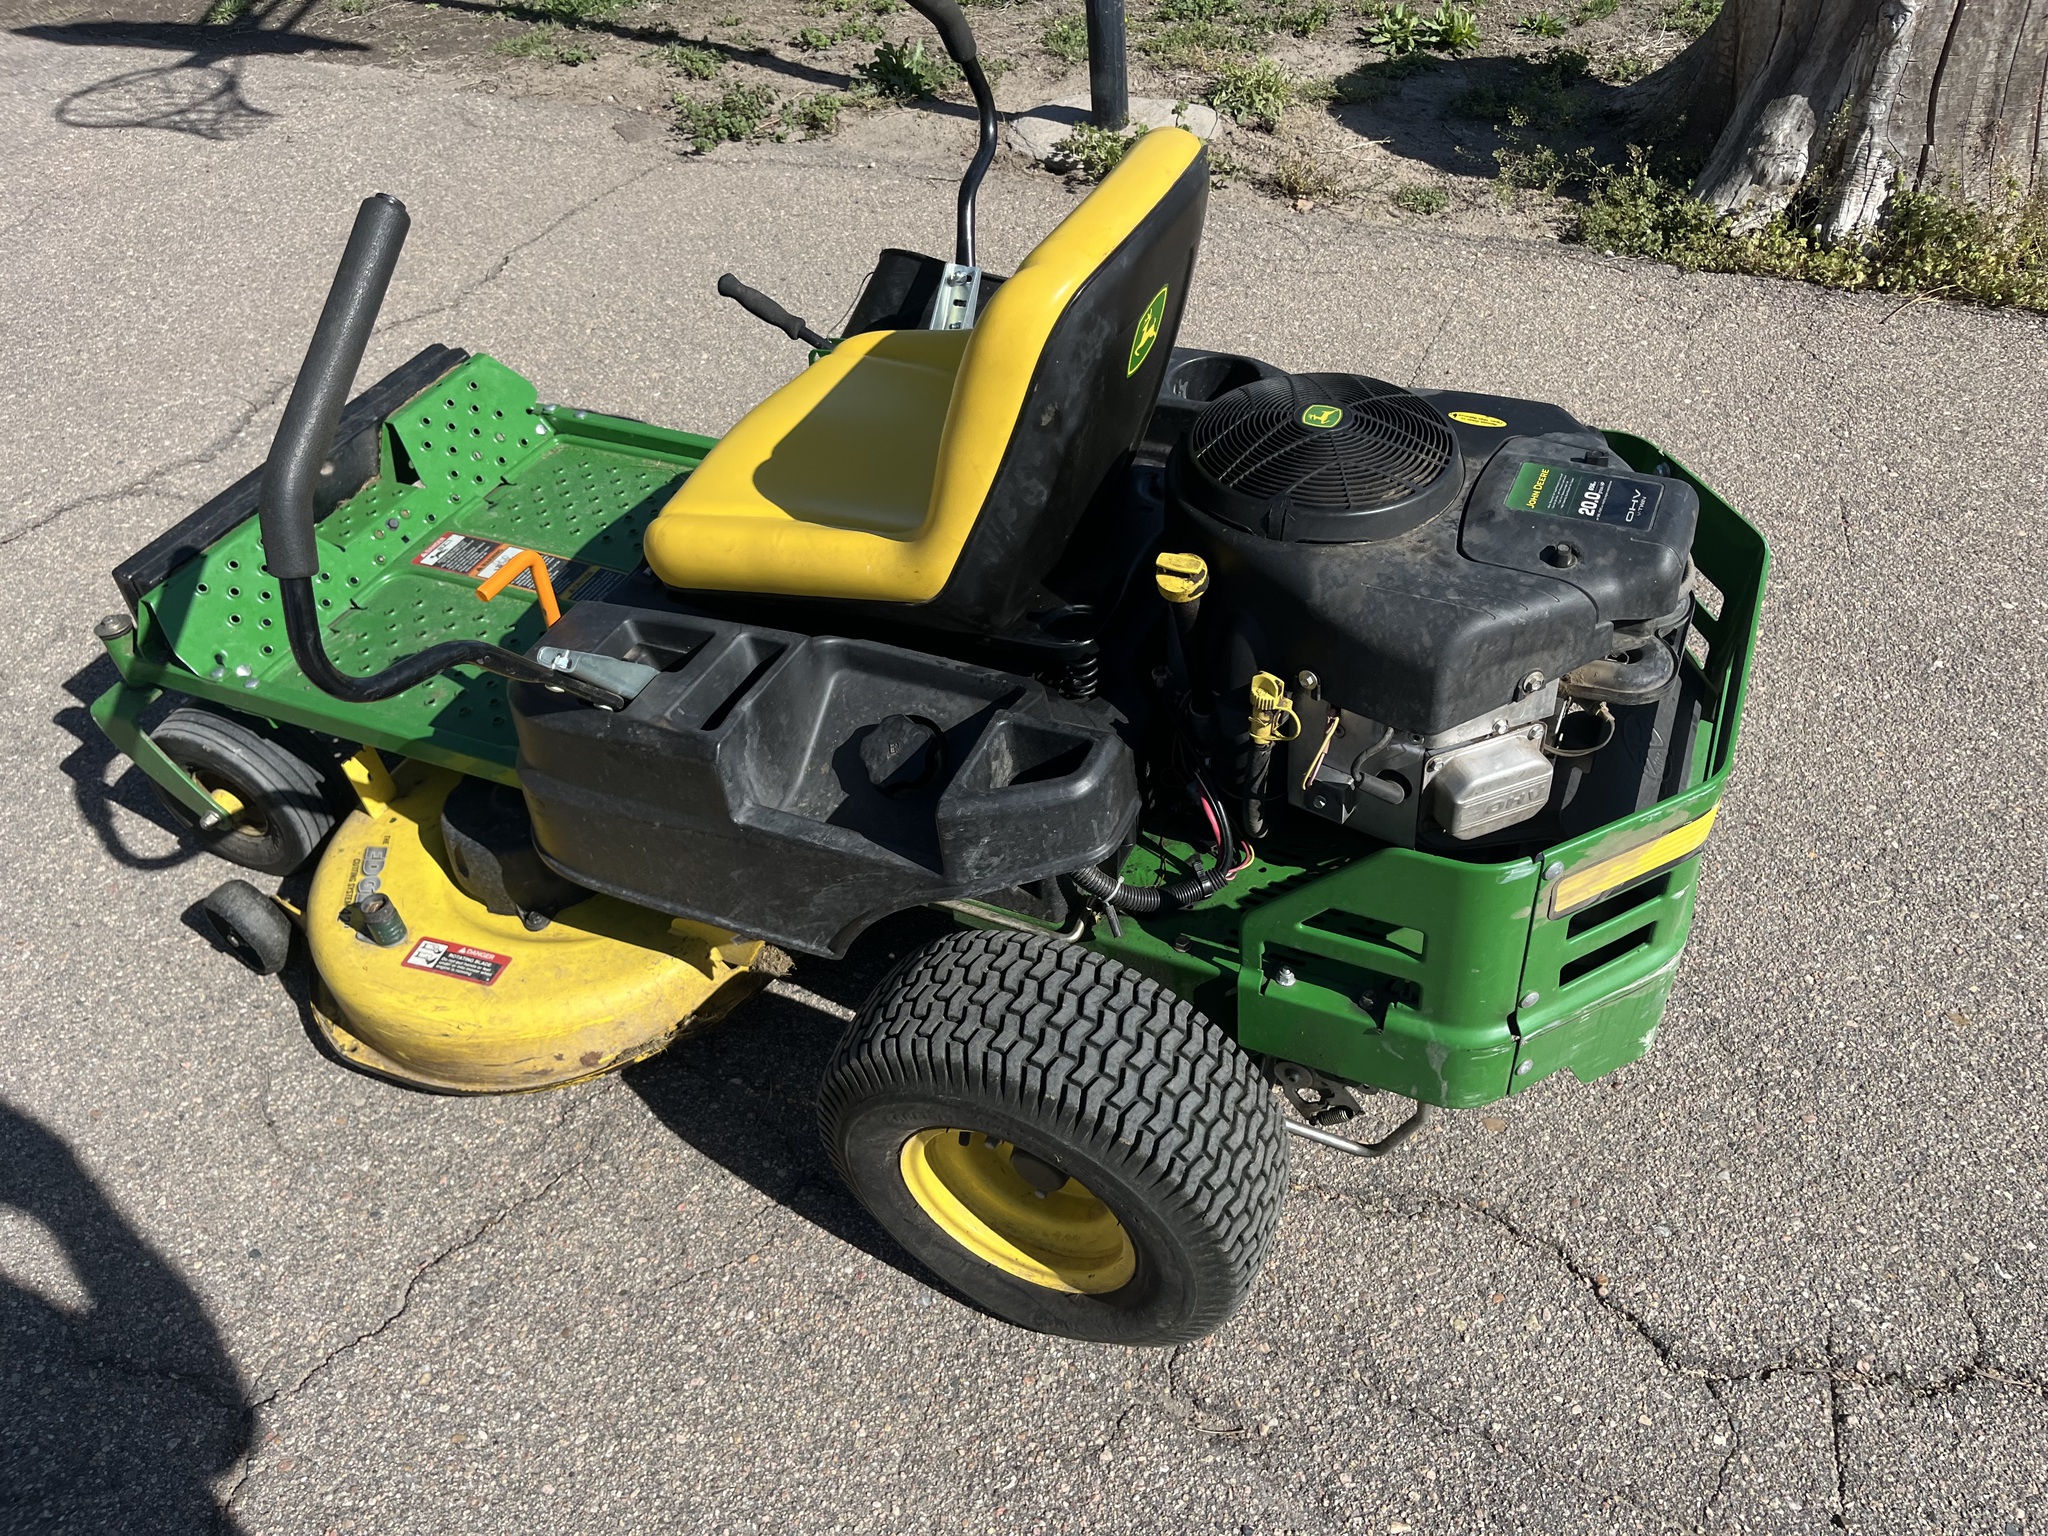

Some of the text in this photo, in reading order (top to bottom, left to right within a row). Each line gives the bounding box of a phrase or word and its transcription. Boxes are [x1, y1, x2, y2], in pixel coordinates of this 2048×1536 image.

[1526, 468, 1550, 509] JOHN DEERE
[1577, 491, 1601, 517] 20.0
[1625, 489, 1642, 523] OHV
[348, 858, 361, 882] CUTTING
[448, 953, 492, 967] ROTATING BLADE
[467, 948, 496, 960] DANGER
